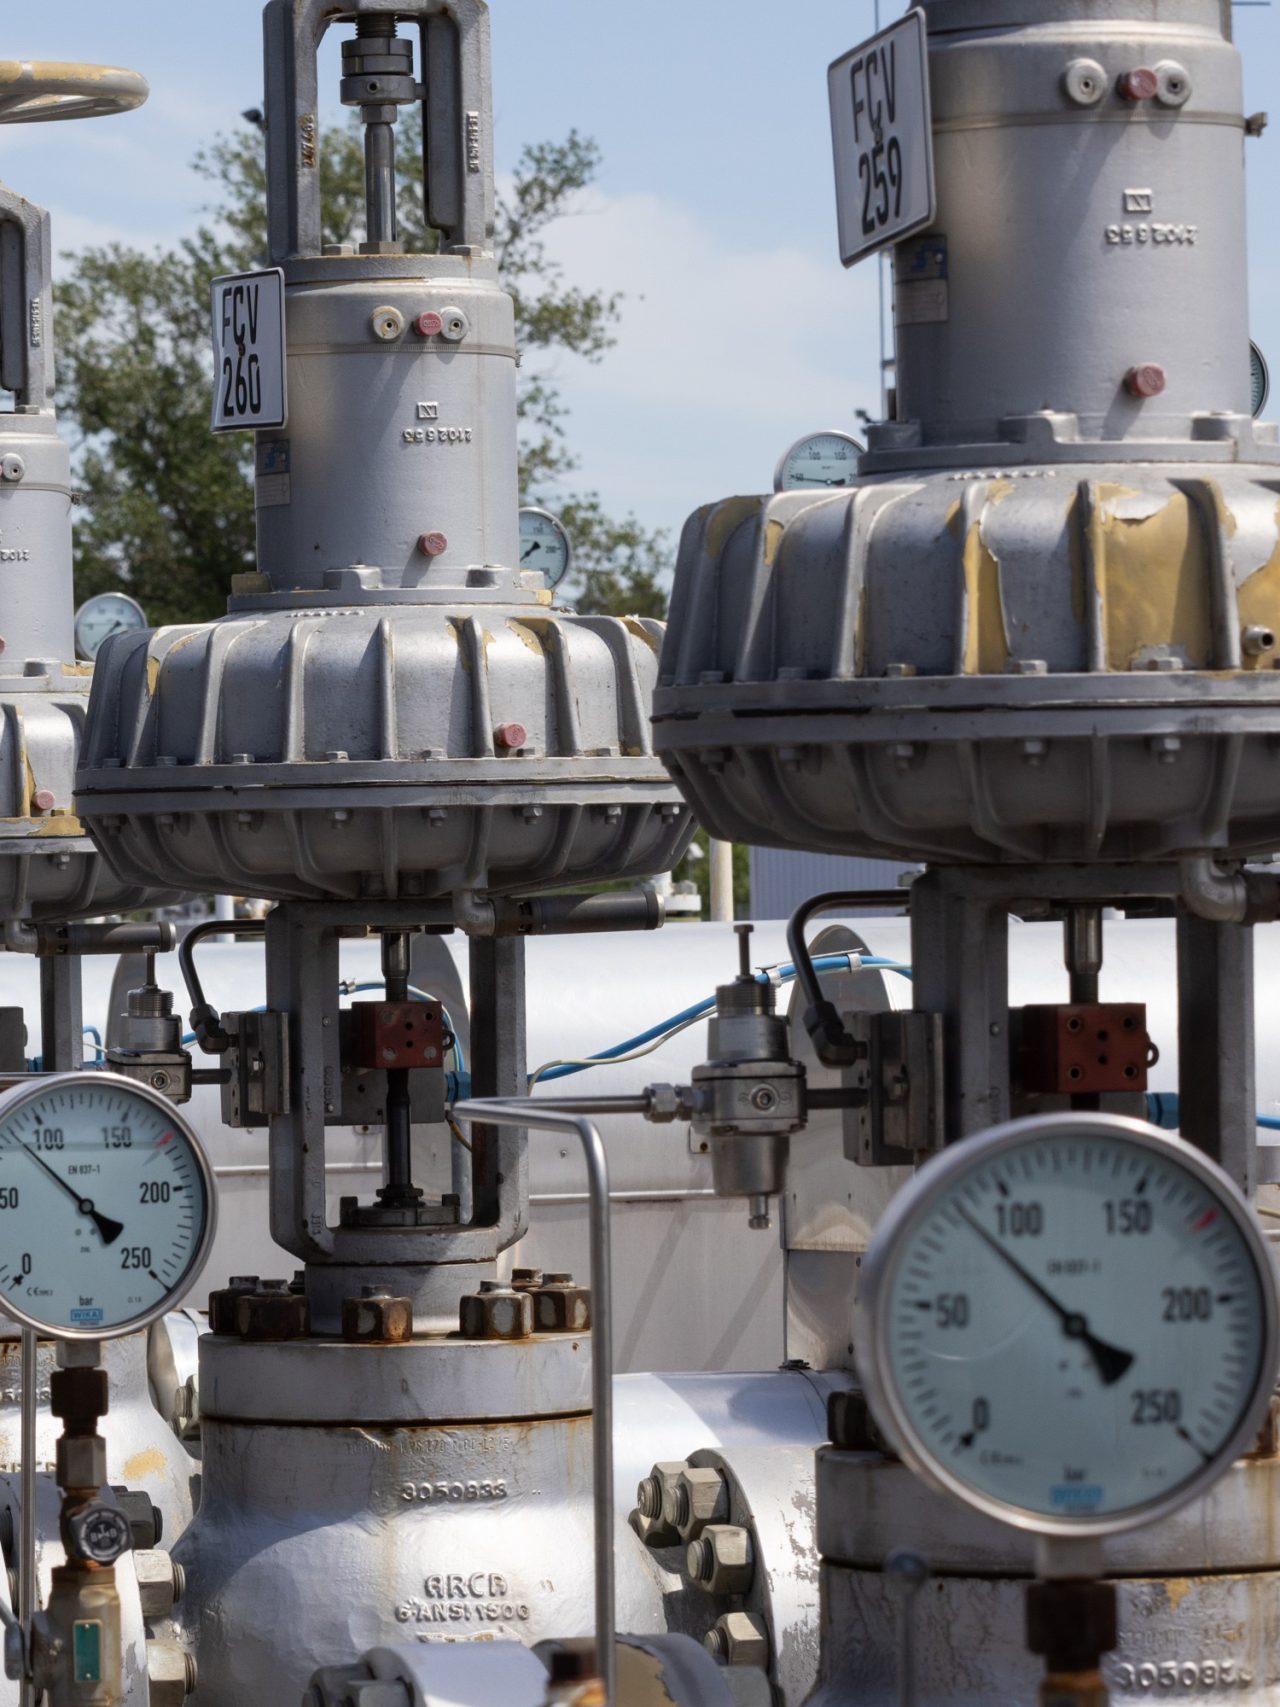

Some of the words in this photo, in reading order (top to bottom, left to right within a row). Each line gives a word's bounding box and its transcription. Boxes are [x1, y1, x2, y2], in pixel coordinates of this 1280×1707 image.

[850, 40, 896, 144] FCV
[858, 136, 902, 235] 259
[222, 284, 259, 348] FCV
[223, 354, 261, 417] 260
[34, 1129, 64, 1150] 100
[102, 1127, 132, 1149] 150
[68, 1165, 77, 1174] EN
[140, 1182, 170, 1204] 200
[996, 1203, 1043, 1236] 100
[1104, 1202, 1152, 1234] 150
[22, 1254, 31, 1274] 0
[121, 1248, 151, 1269] 250
[79, 1296, 93, 1306] bar
[936, 1294, 969, 1328] 50
[1162, 1288, 1212, 1322] 200
[973, 1398, 989, 1431] 0
[1131, 1390, 1181, 1424] 250
[424, 1572, 508, 1598] ARCA
